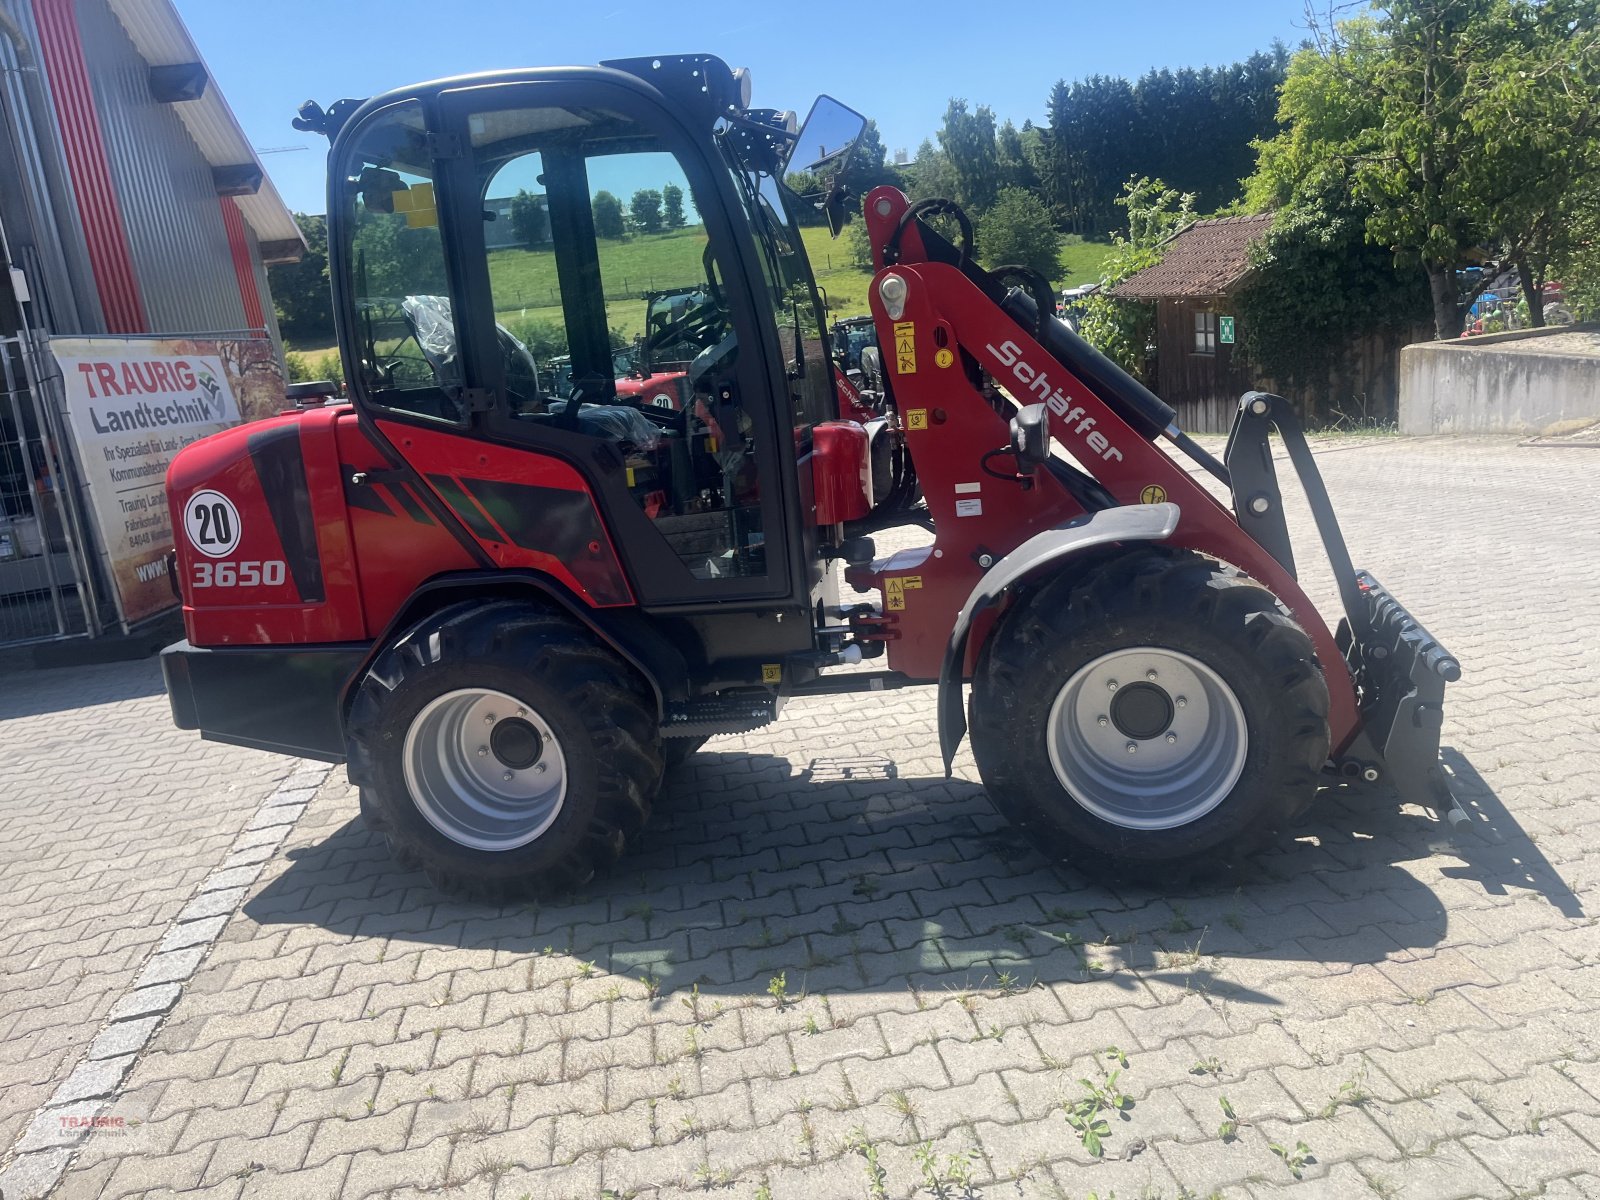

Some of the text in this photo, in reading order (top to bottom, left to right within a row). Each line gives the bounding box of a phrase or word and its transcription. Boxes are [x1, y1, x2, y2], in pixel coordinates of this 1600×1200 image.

[78, 360, 197, 398] TRAURIG
[89, 397, 212, 434] Landtechnik
[985, 340, 1124, 463] Schäffer
[103, 446, 117, 462] Ihr
[115, 441, 152, 462] Spezialist
[118, 494, 148, 513] Traurig
[195, 503, 231, 545] 20
[193, 560, 286, 588] 3650
